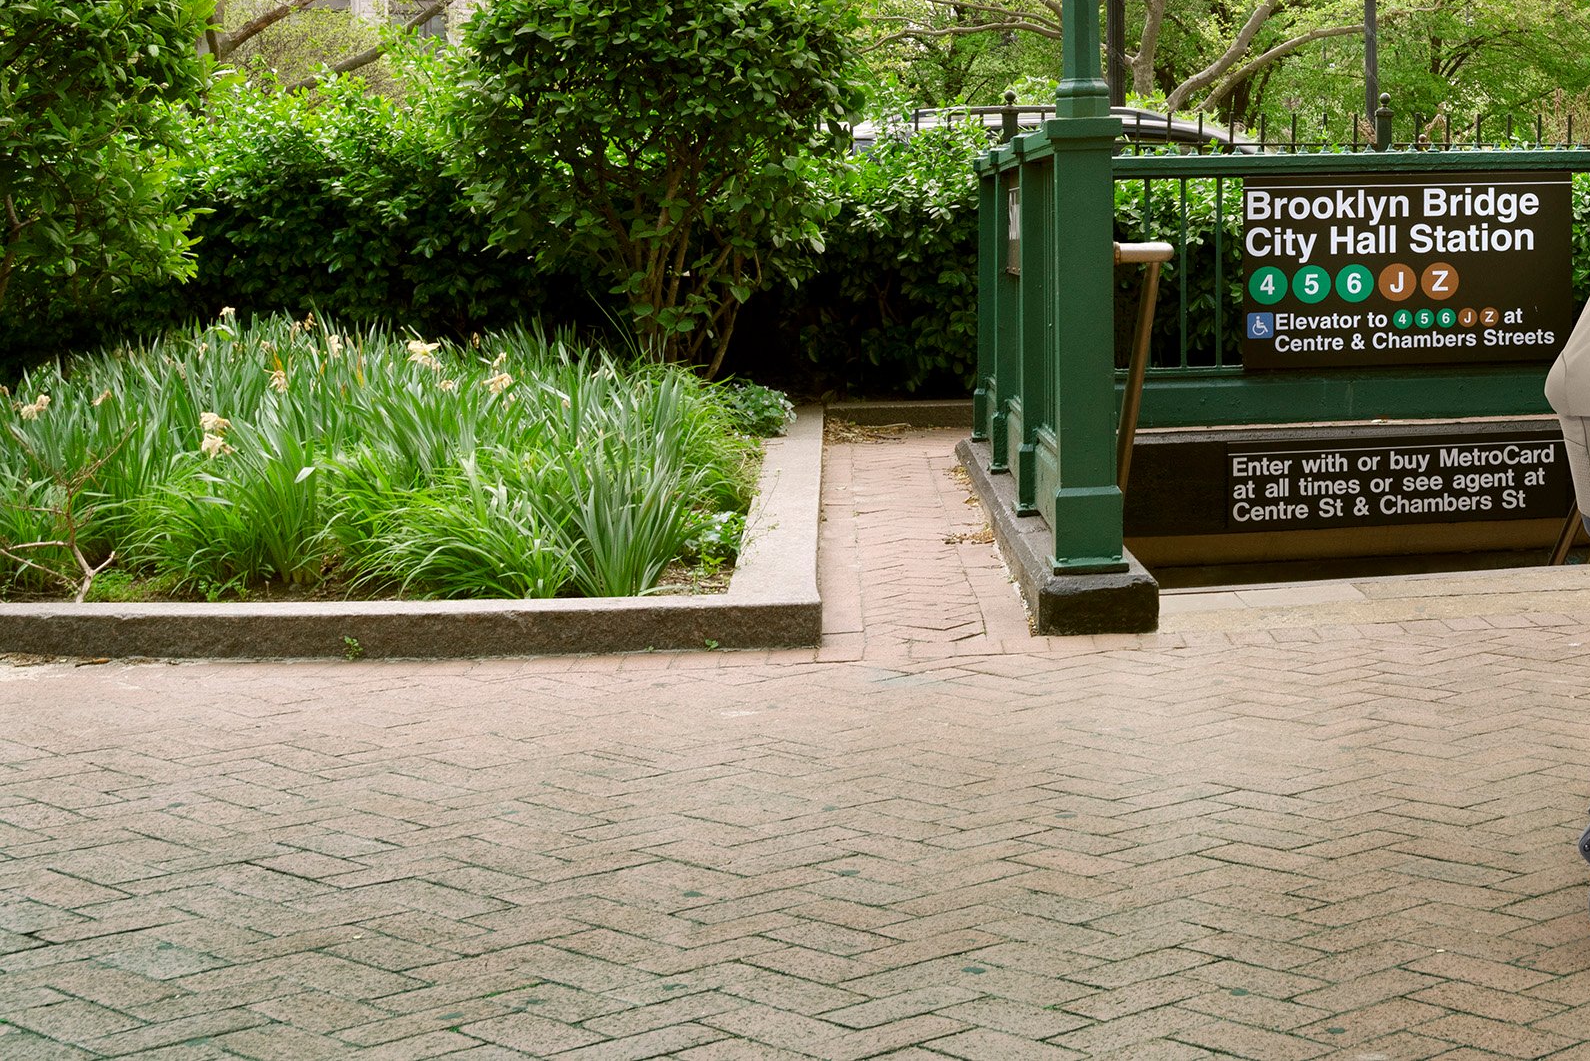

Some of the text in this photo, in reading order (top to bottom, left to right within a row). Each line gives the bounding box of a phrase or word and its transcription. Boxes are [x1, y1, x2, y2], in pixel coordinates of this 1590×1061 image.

[1246, 186, 1540, 226] Brooklyn Bridge
[1245, 222, 1534, 264] City Hall Station
[1259, 270, 1449, 295] 4 5 6 J Z
[1275, 307, 1523, 331] Elevator to 4 5 6 J Z at
[1274, 328, 1555, 353] Centre & Chambers Streets
[1232, 443, 1555, 477] Enter with or buy MetroCard
[1232, 467, 1546, 500] at all times or see agent at
[1232, 489, 1526, 522] Centre St & Chambers St
